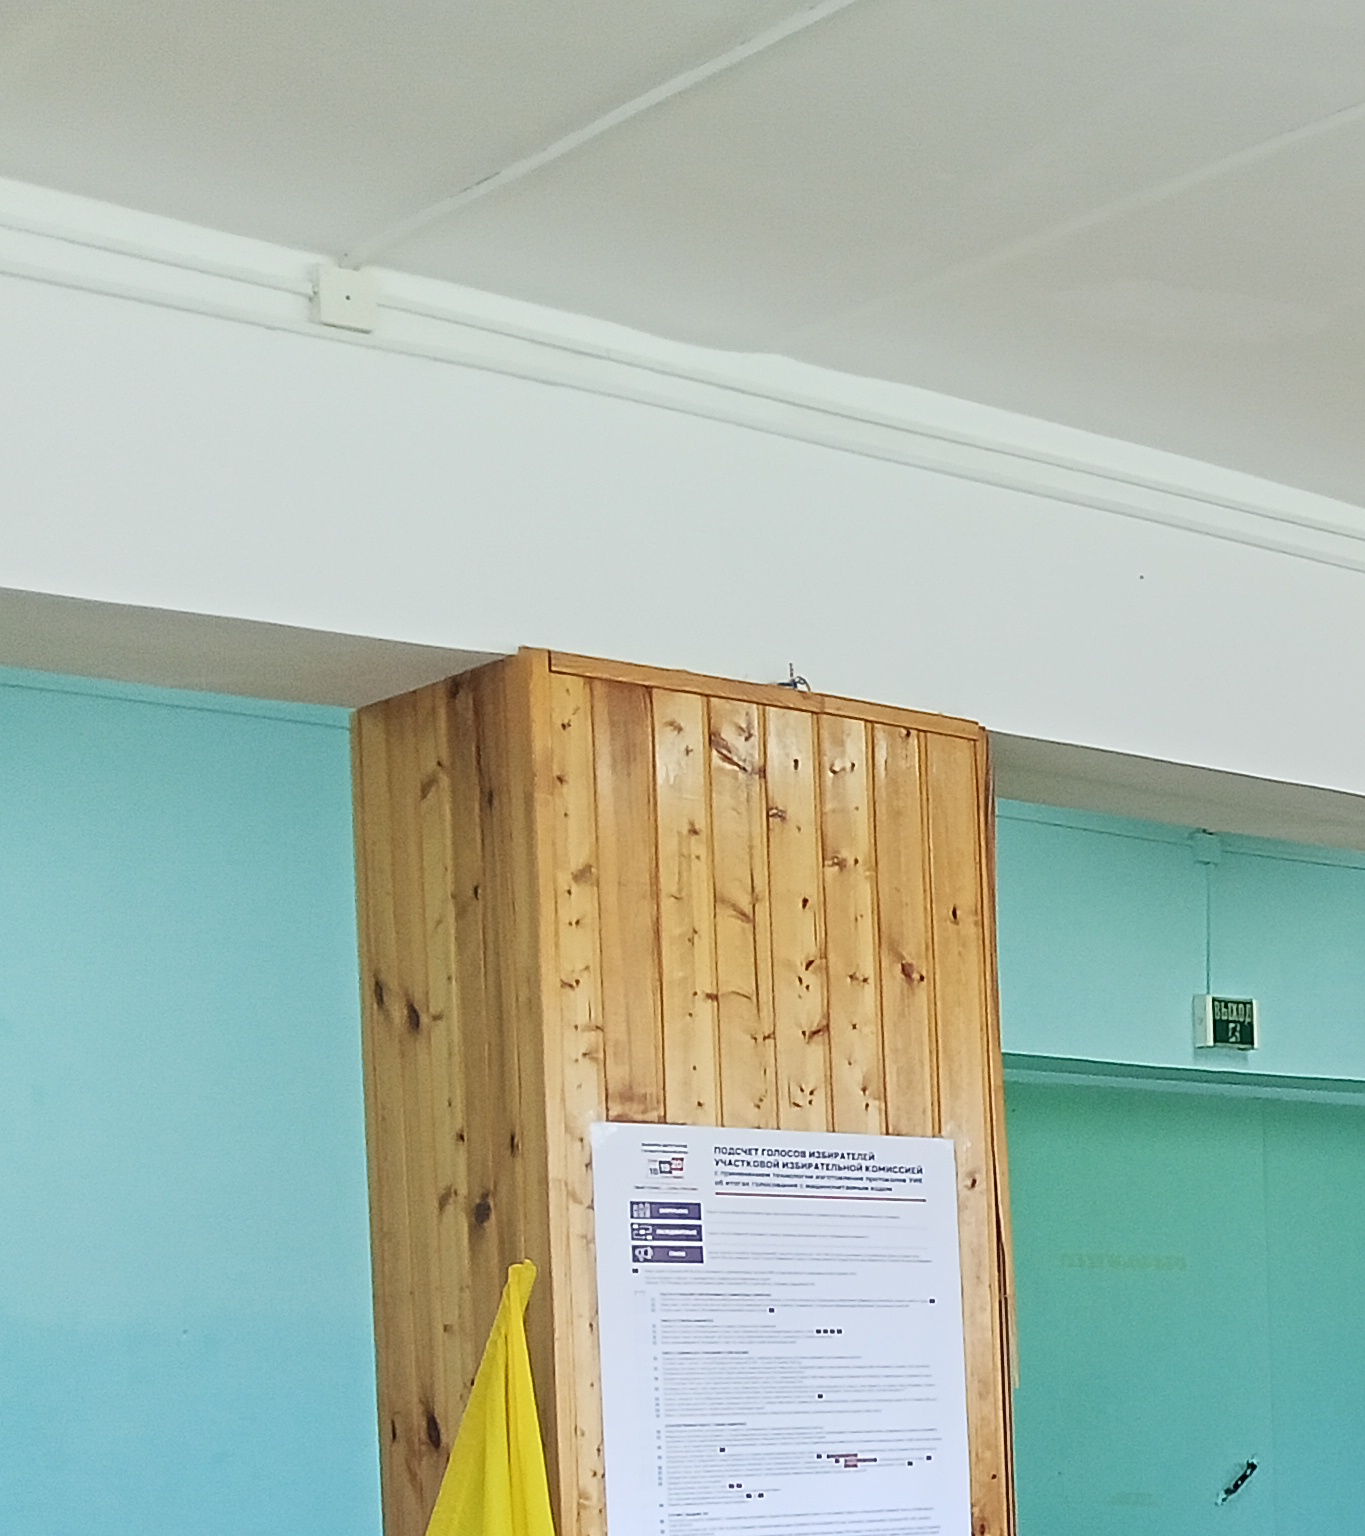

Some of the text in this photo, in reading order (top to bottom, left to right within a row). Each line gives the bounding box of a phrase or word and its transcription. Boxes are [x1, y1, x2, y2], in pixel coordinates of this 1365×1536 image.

[1214, 1001, 1252, 1024] ВЫХОД
[714, 1146, 875, 1161] ПОДСЧЕТ ГОЛОСОВ ИЗБИРАТЕЛЕЙ
[714, 1158, 923, 1175] УЧАСТКОВОЙ ИЗБИРАТЕЛЬНОЙ КОМИССИЕЙ
